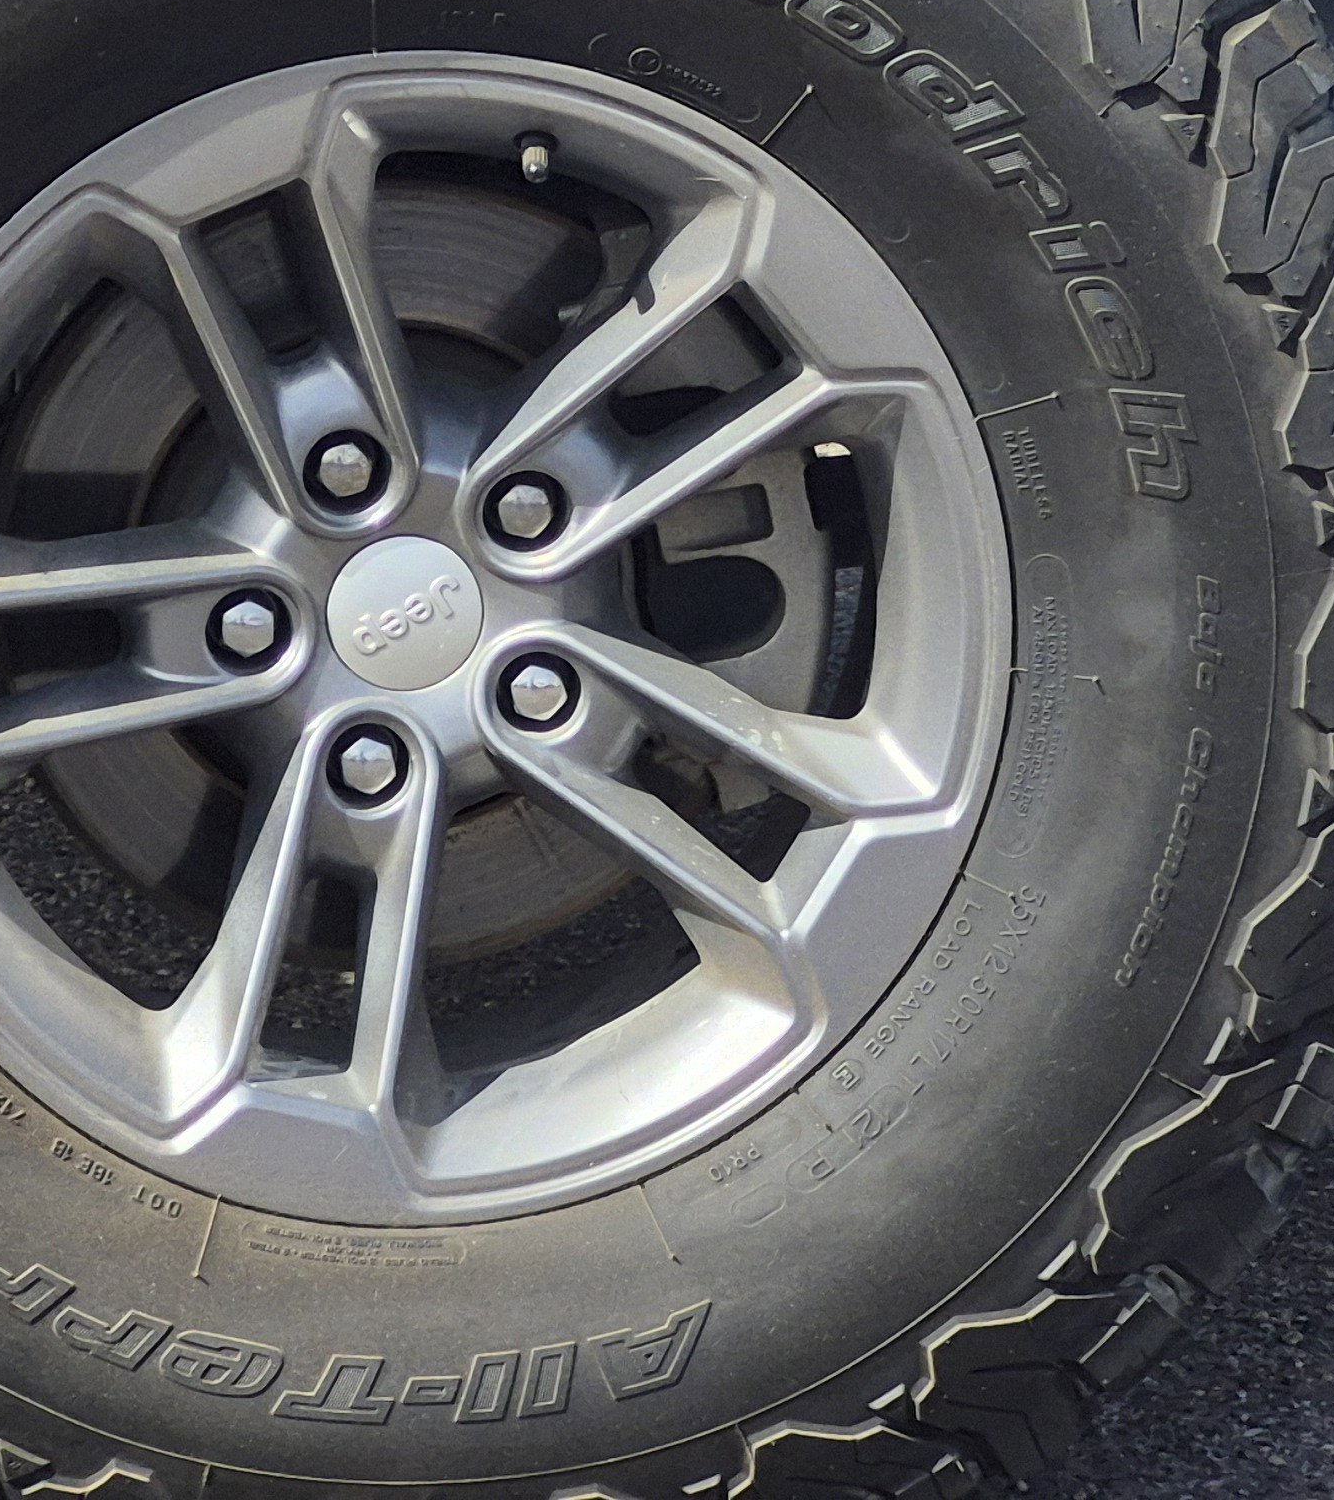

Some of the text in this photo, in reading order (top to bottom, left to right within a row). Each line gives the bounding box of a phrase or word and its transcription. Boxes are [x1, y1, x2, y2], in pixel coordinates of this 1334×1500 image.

[352, 575, 460, 656] Jeep
[1114, 726, 1215, 989] Champion
[928, 896, 984, 974] LOAD
[864, 973, 935, 1058] RANGE
[133, 1186, 183, 1219] DOT
[708, 1143, 761, 1183] PR10
